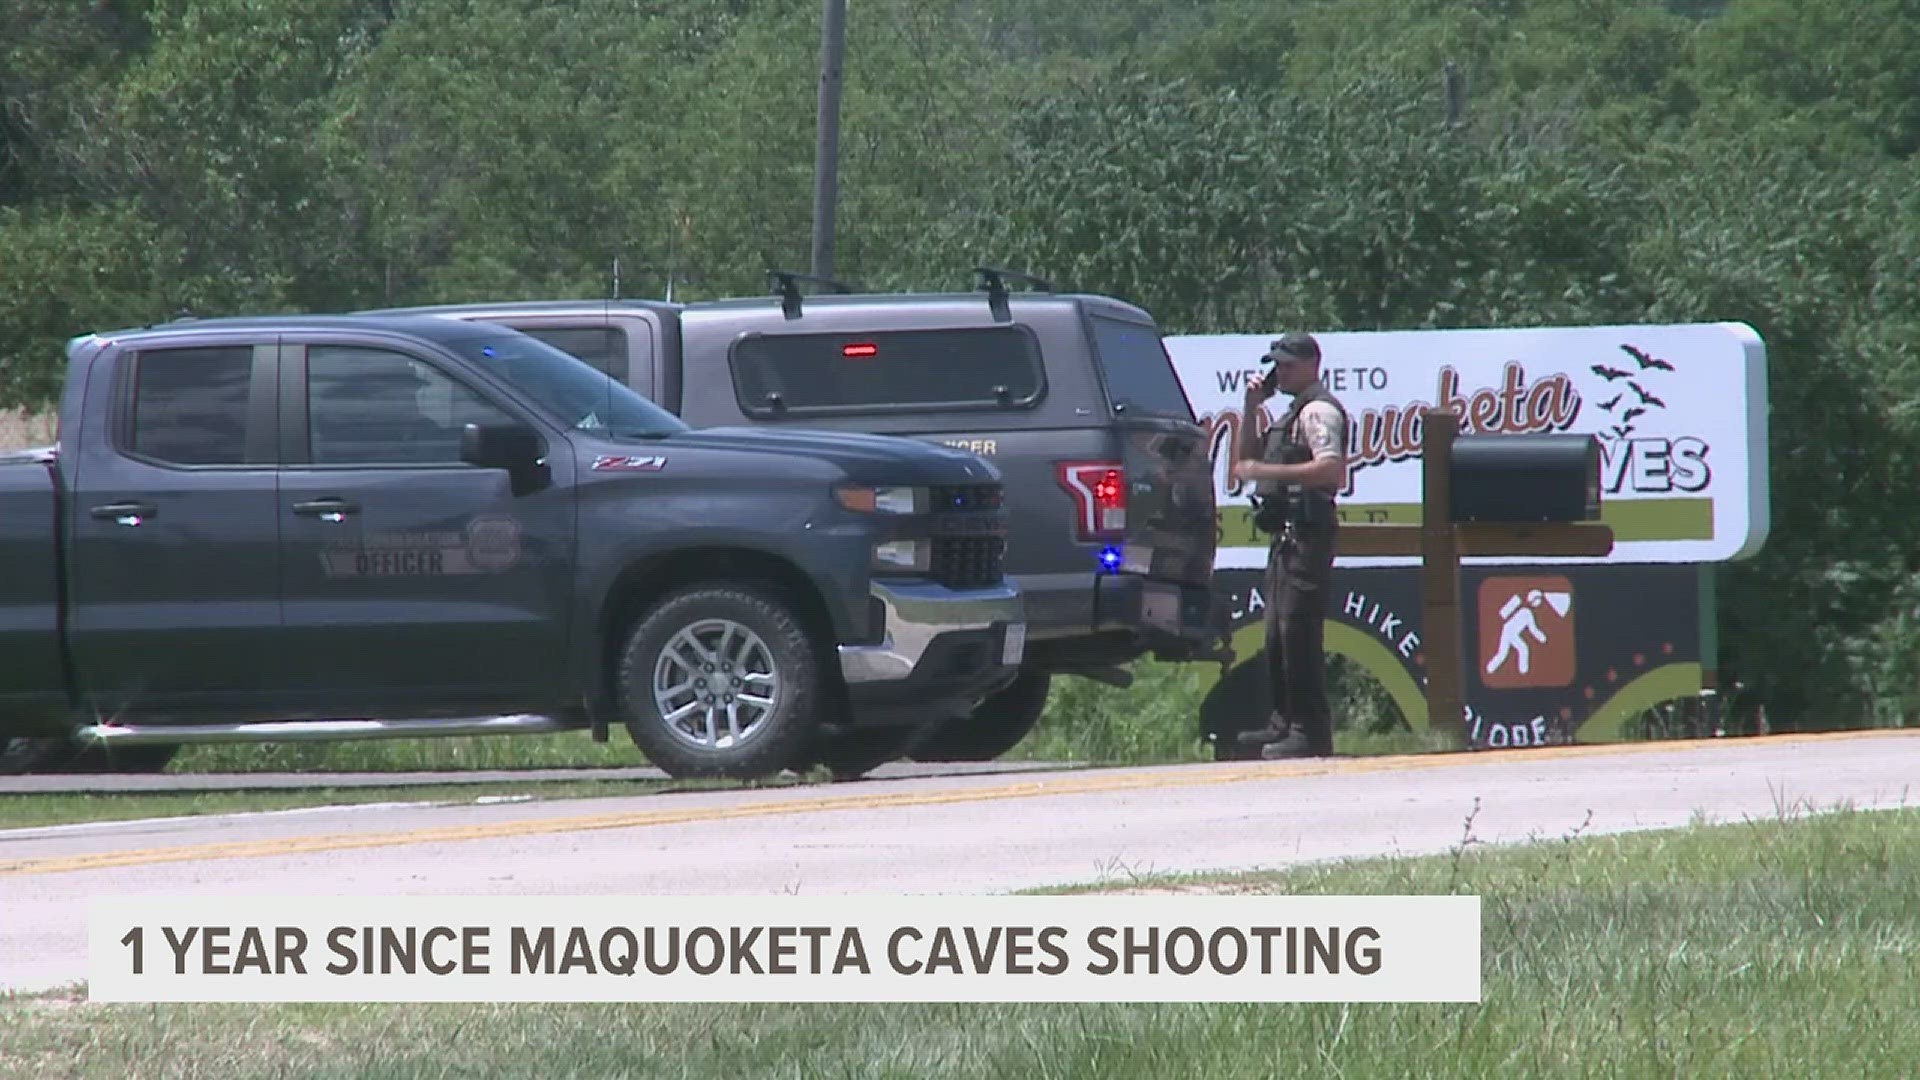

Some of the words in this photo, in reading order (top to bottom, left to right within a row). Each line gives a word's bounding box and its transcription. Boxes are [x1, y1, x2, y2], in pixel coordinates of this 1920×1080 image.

[1216, 368, 1346, 392] WEME
[1353, 367, 1387, 390] TO
[592, 456, 667, 471] Z71
[1601, 436, 1708, 492] VES
[355, 551, 444, 577] OFFICER
[1344, 591, 1420, 658] HIKE
